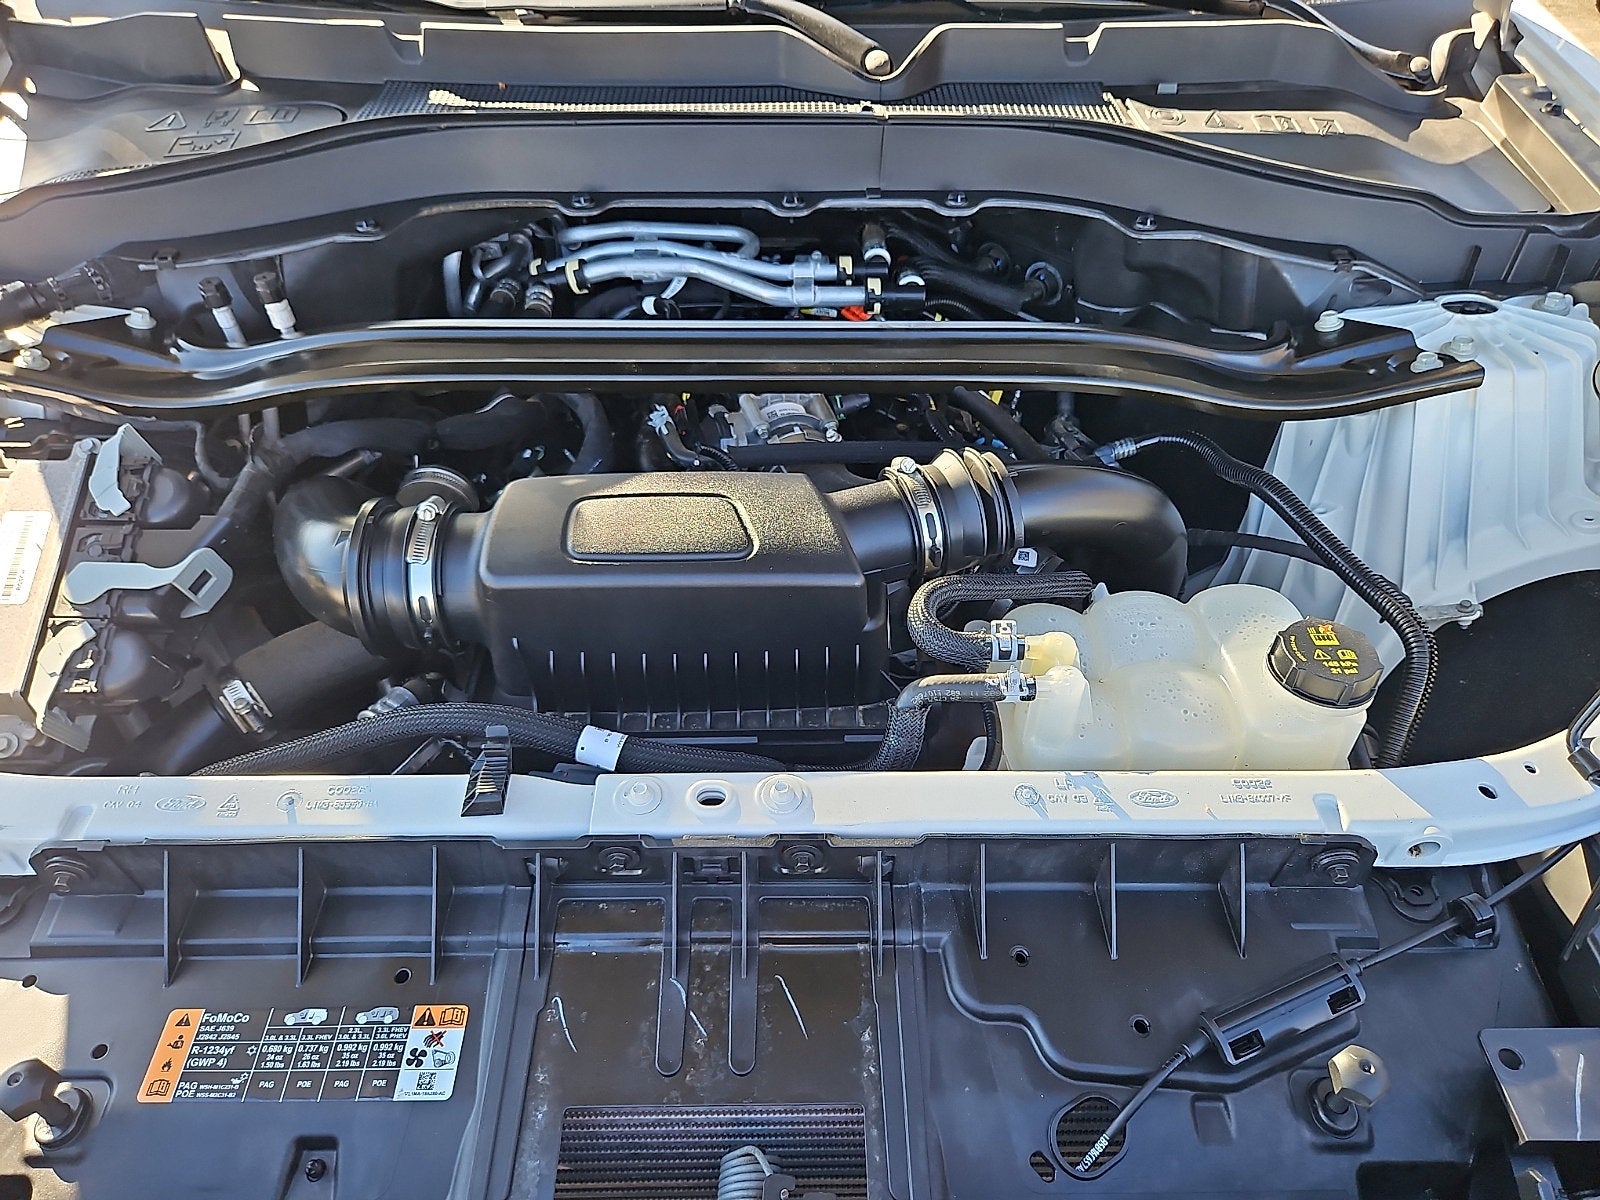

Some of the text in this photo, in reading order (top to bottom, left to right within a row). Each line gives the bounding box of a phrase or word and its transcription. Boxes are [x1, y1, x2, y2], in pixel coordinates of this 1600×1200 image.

[202, 1013, 250, 1023] FoMoCo
[196, 1033, 240, 1041] J2842 J2845
[190, 1046, 236, 1056] R-1234yf
[262, 1045, 293, 1055] 0.680 kg
[298, 1045, 329, 1055] 0.737 kg
[337, 1044, 368, 1054] 0.992 kg
[373, 1043, 404, 1053] 0.992 kg
[186, 1058, 228, 1068] (GWP 4)
[386, 1059, 397, 1067] lbs
[178, 1082, 198, 1090] PAG
[333, 1080, 350, 1088] PAG
[175, 1090, 196, 1098] POE
